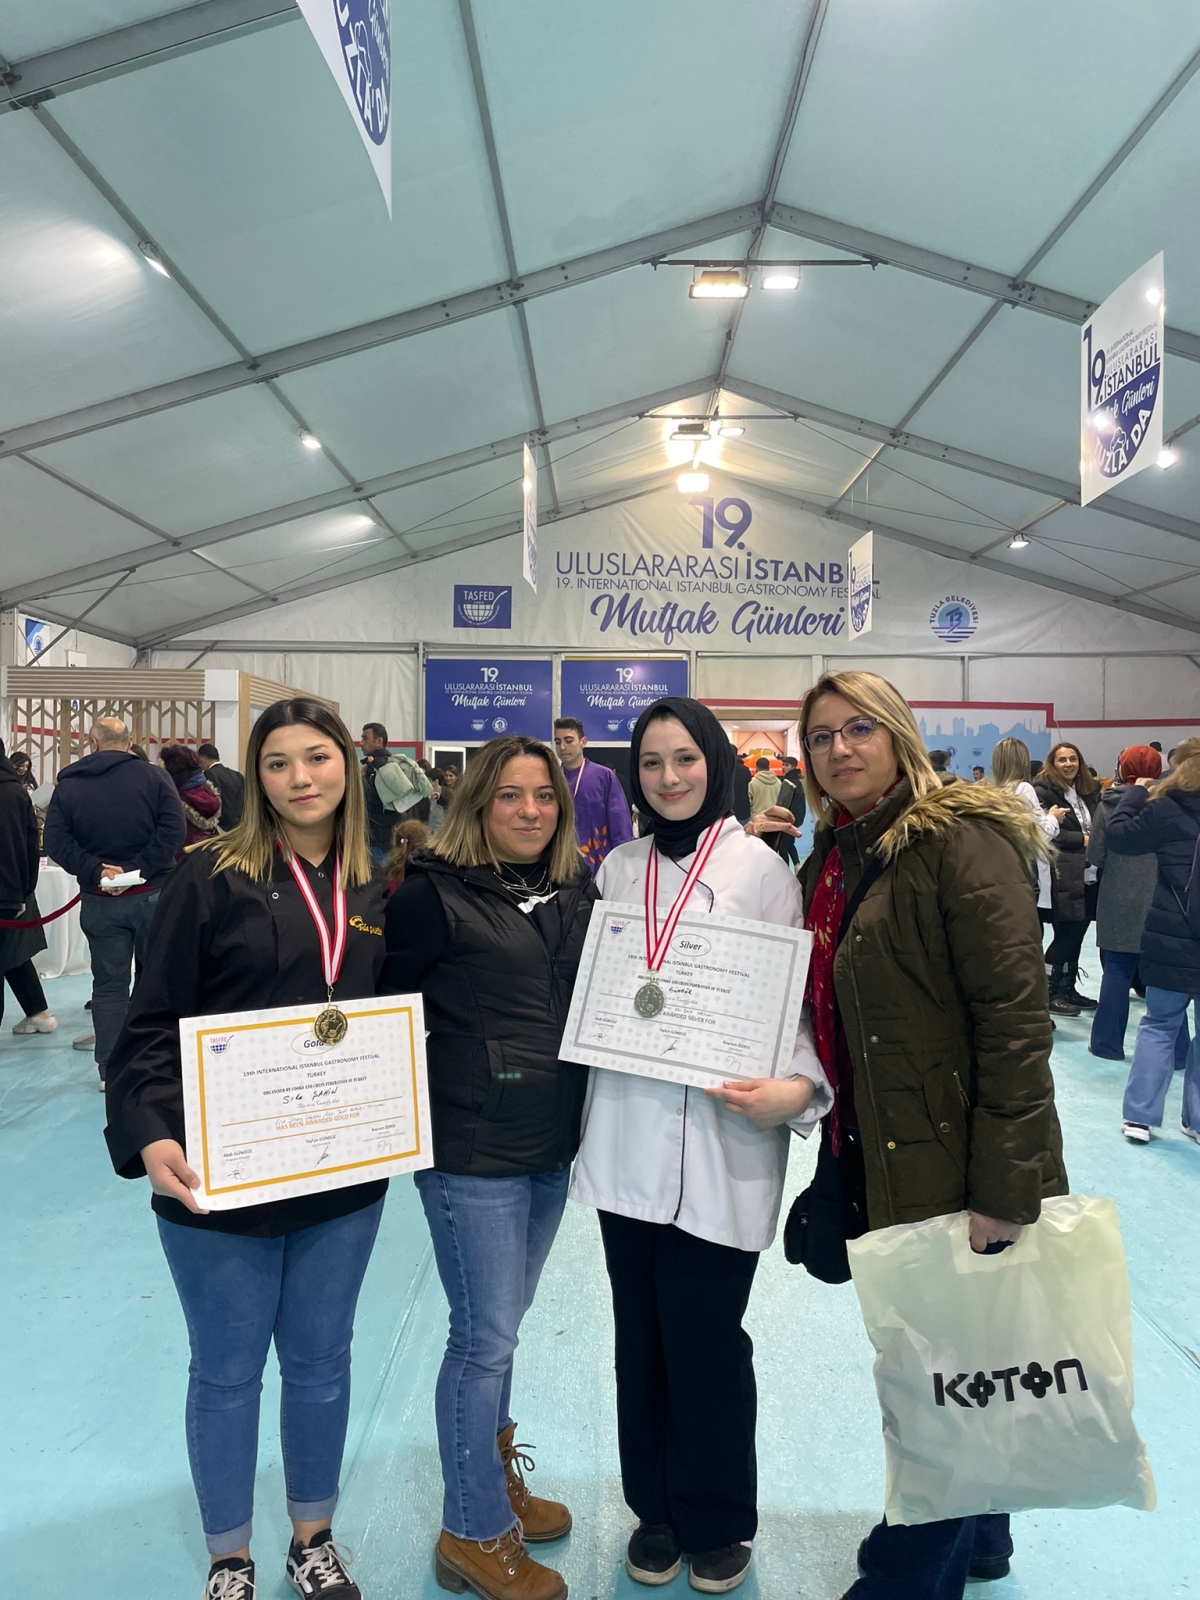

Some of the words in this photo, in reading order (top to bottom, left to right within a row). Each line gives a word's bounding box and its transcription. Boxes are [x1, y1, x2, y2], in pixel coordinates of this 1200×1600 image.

[689, 496, 752, 550] 19.
[556, 552, 738, 580] ULUSLARARASI
[746, 552, 880, 585] İSTANBL
[556, 577, 573, 589] 19.
[577, 578, 673, 592] INTERNATIONAL
[677, 580, 733, 594] ISTANBUL
[736, 582, 828, 597] GASTRONOMY
[464, 590, 494, 601] TASFED
[590, 592, 719, 646] Mutfak
[731, 600, 846, 643] Günleri
[930, 600, 945, 624] TUZLA
[480, 667, 498, 682] 19.
[616, 668, 634, 683] 19.
[444, 683, 495, 691] ULUSLARARASI
[496, 682, 533, 691] İSTANBUL
[631, 682, 668, 691] İSTANBUL
[451, 694, 490, 710] Mutfak
[492, 695, 526, 708] Günleri
[586, 694, 626, 710] Mutfak
[679, 940, 702, 950] Silver
[694, 964, 728, 973] GASTRONOMY
[728, 970, 750, 978] FESTIVAL
[662, 1012, 687, 1020] AWARDED
[688, 1015, 704, 1023] SILVER
[256, 1065, 298, 1075] INTERNATIONAL
[324, 1057, 360, 1066] GASTRONOMY
[289, 1121, 304, 1129] BEEN
[305, 1117, 333, 1126] AWARDED
